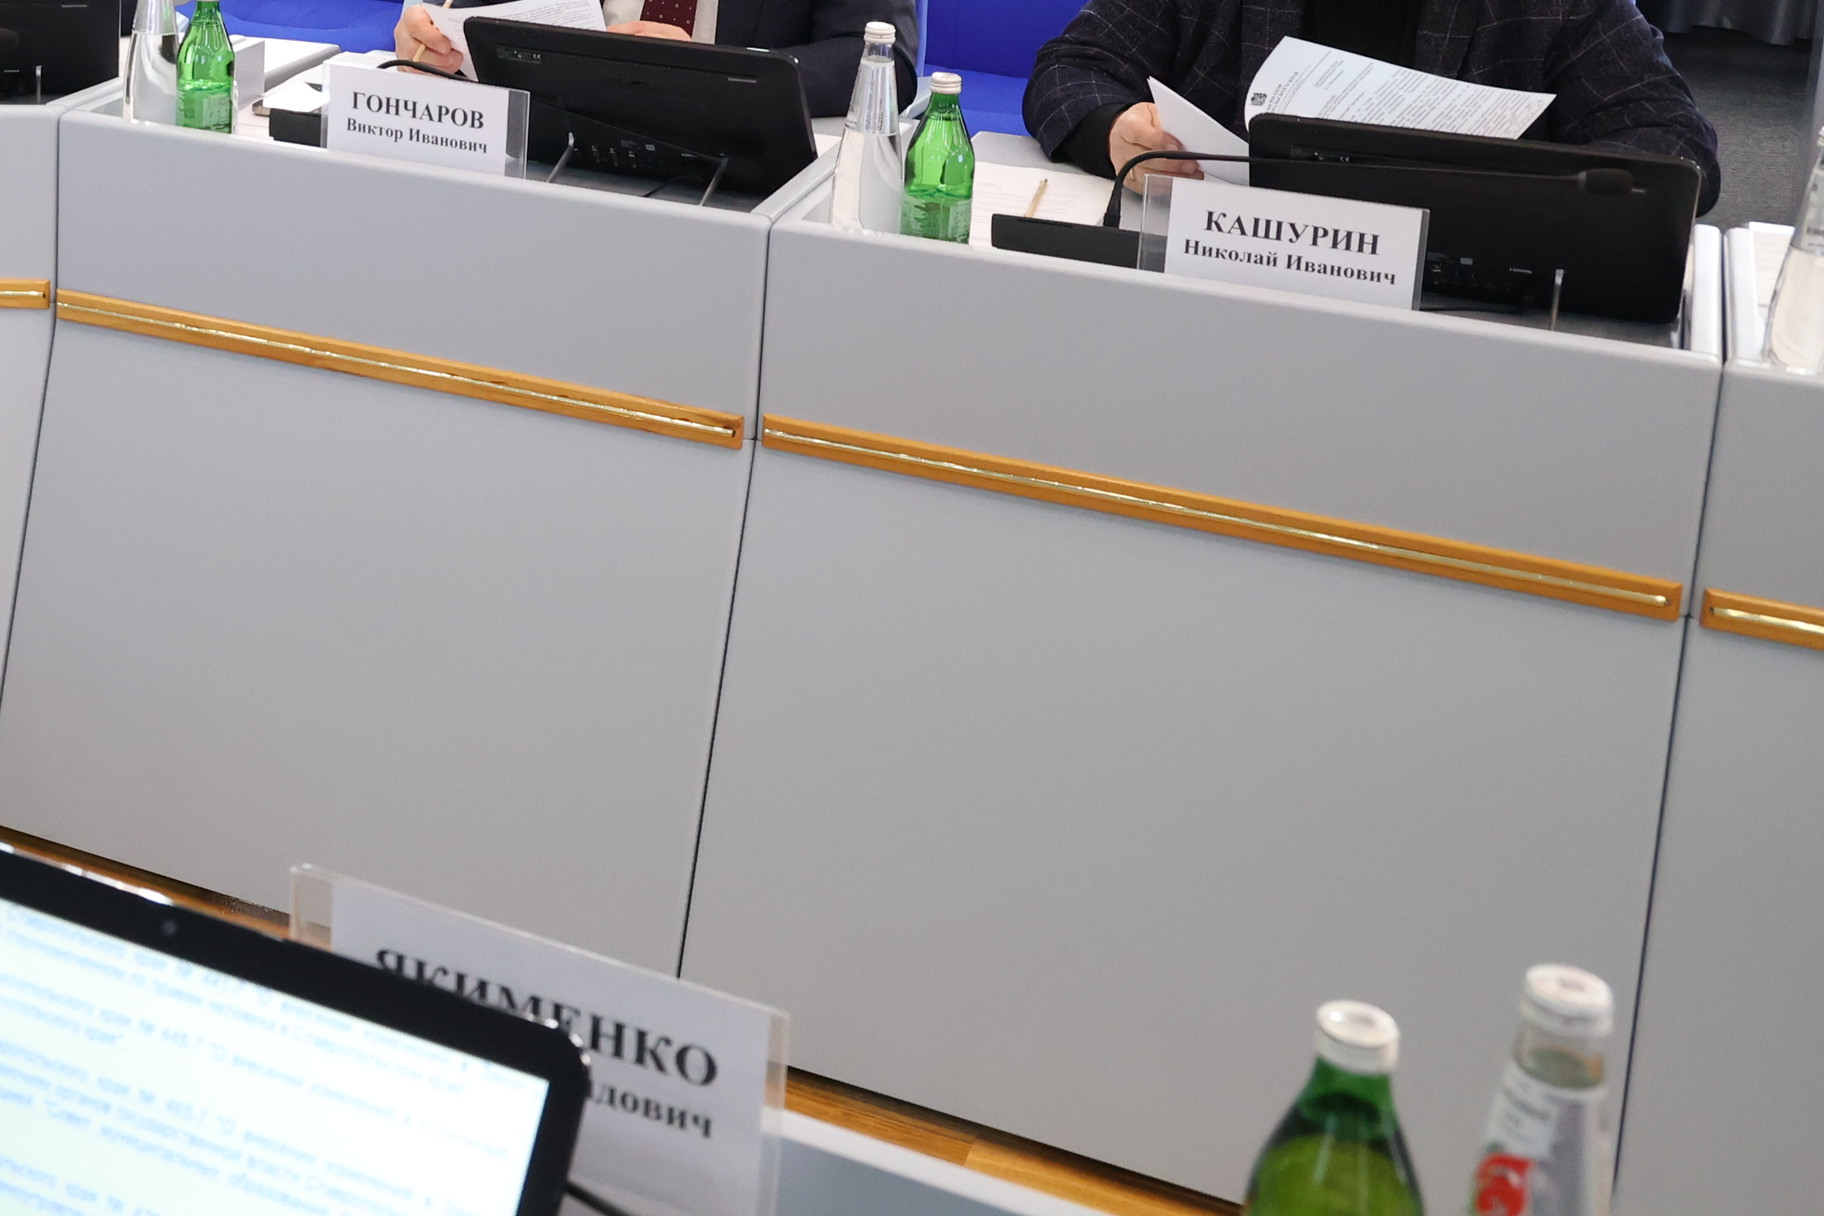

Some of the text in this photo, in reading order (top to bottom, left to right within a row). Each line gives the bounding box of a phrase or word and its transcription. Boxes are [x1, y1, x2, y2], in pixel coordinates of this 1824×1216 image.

[352, 91, 485, 129] ГОНЧАРОВ
[346, 117, 488, 154] Виктор Иванович
[1203, 210, 1381, 256] КАШУРИН
[1183, 239, 1396, 285] Николай Иванович
